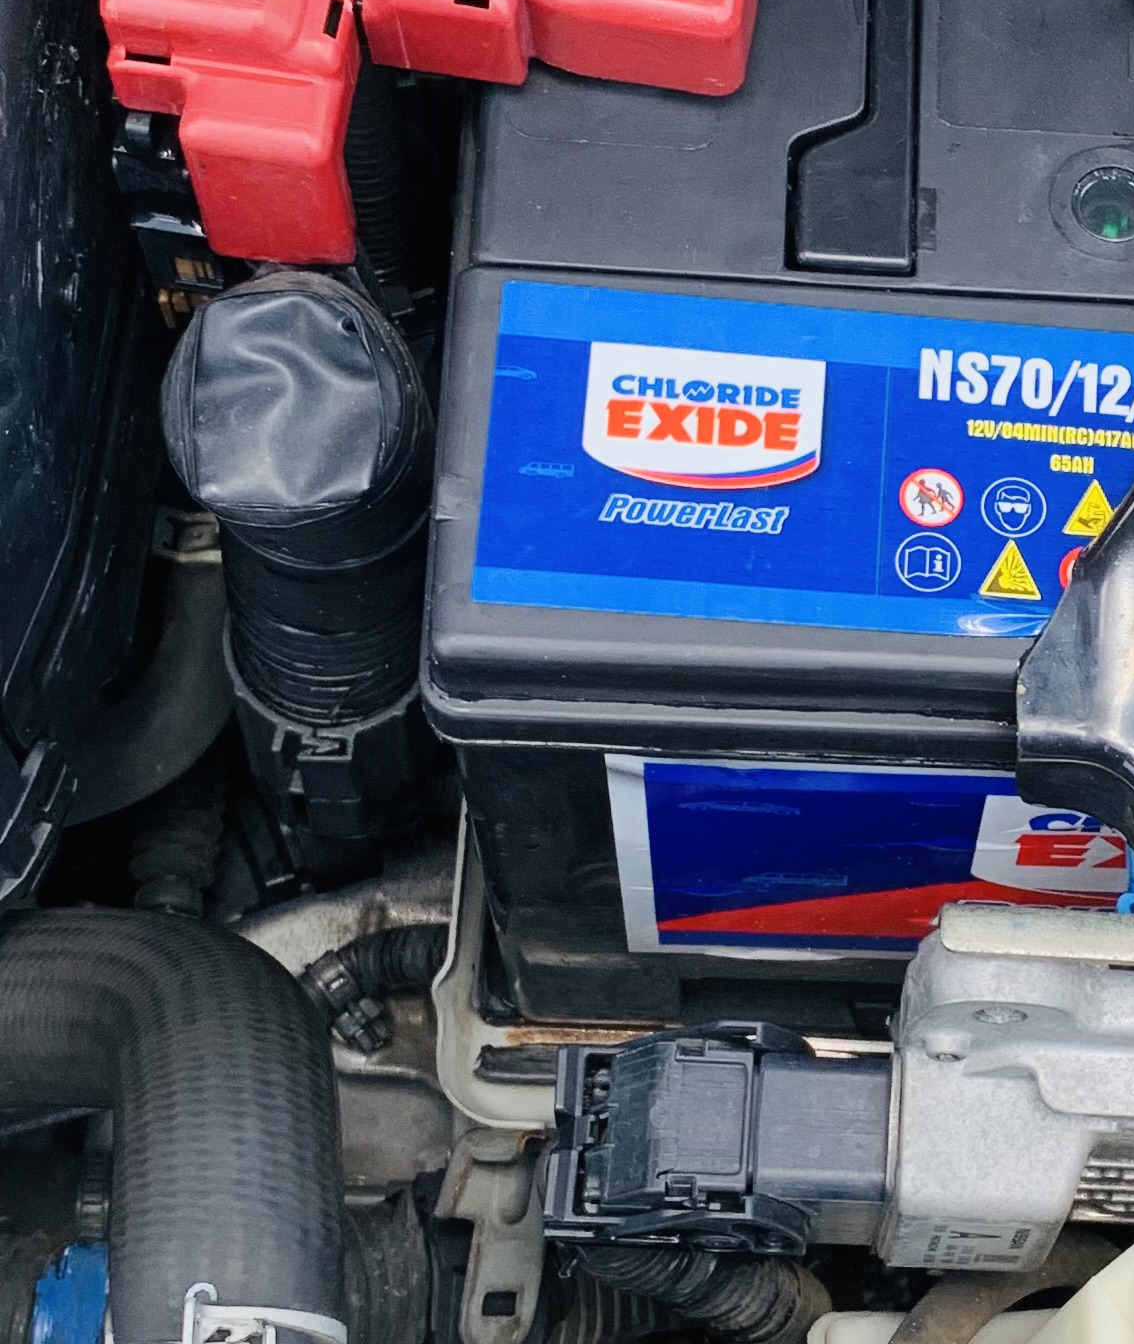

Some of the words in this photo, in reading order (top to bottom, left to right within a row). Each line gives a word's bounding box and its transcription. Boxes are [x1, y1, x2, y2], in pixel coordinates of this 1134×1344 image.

[612, 374, 802, 409] CHLORIDE
[606, 398, 802, 452] EXIDE
[1050, 454, 1095, 475] 65AH
[598, 493, 790, 535] PowerLast
